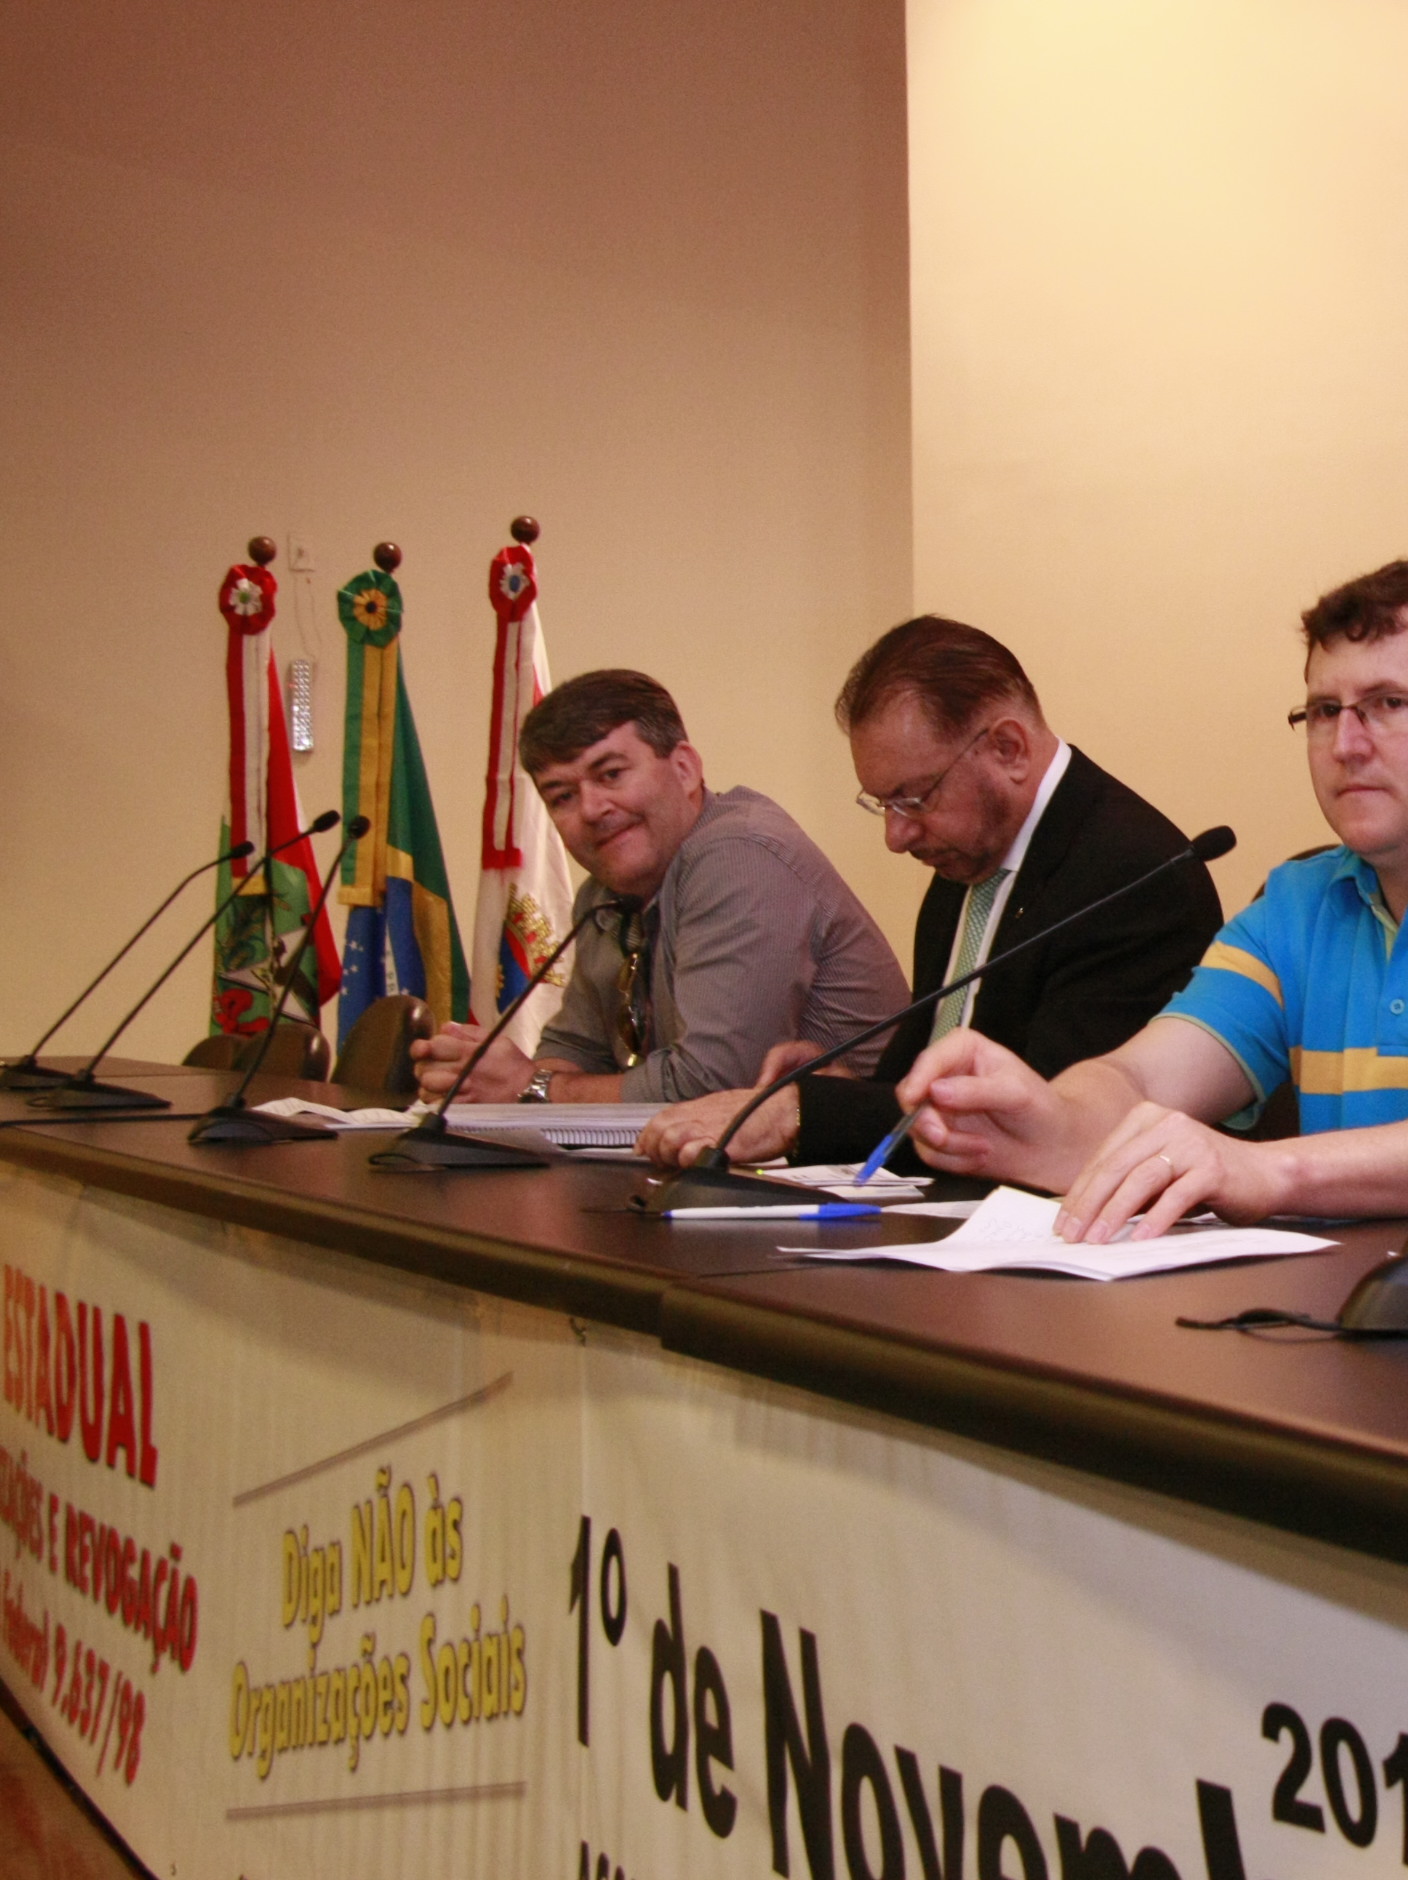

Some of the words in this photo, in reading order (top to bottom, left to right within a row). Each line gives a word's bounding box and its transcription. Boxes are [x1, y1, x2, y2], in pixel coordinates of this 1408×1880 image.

[4, 1263, 158, 1489] ESTADUAL
[65, 1501, 198, 1675] REVOGAÇÃO
[282, 1526, 343, 1648] Diga
[352, 1464, 415, 1610] NÃO
[425, 1471, 463, 1588] às
[229, 1632, 412, 1782] Organizações
[419, 1593, 527, 1733] Sociais
[650, 1561, 738, 1839] de
